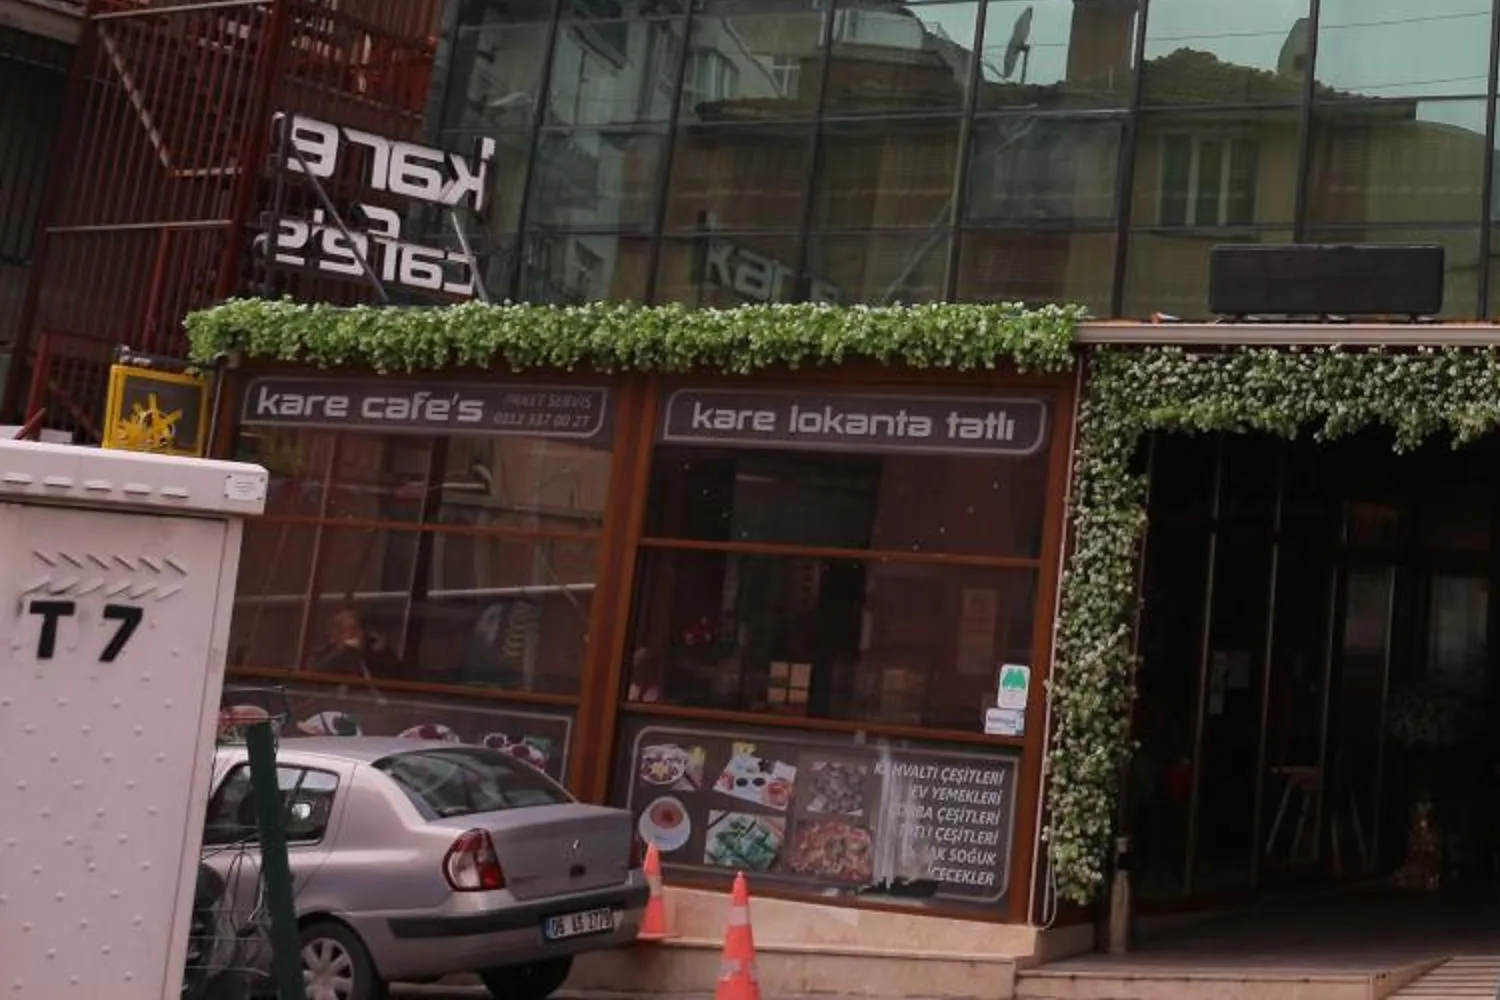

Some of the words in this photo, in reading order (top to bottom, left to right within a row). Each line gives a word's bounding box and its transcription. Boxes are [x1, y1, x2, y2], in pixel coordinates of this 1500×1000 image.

[256, 386, 349, 417] kare
[361, 391, 485, 422] cafe's
[692, 402, 776, 432] kare
[789, 405, 932, 437] lokanta
[946, 410, 1016, 441] tatlı
[29, 600, 75, 660] T
[98, 604, 144, 662] 7
